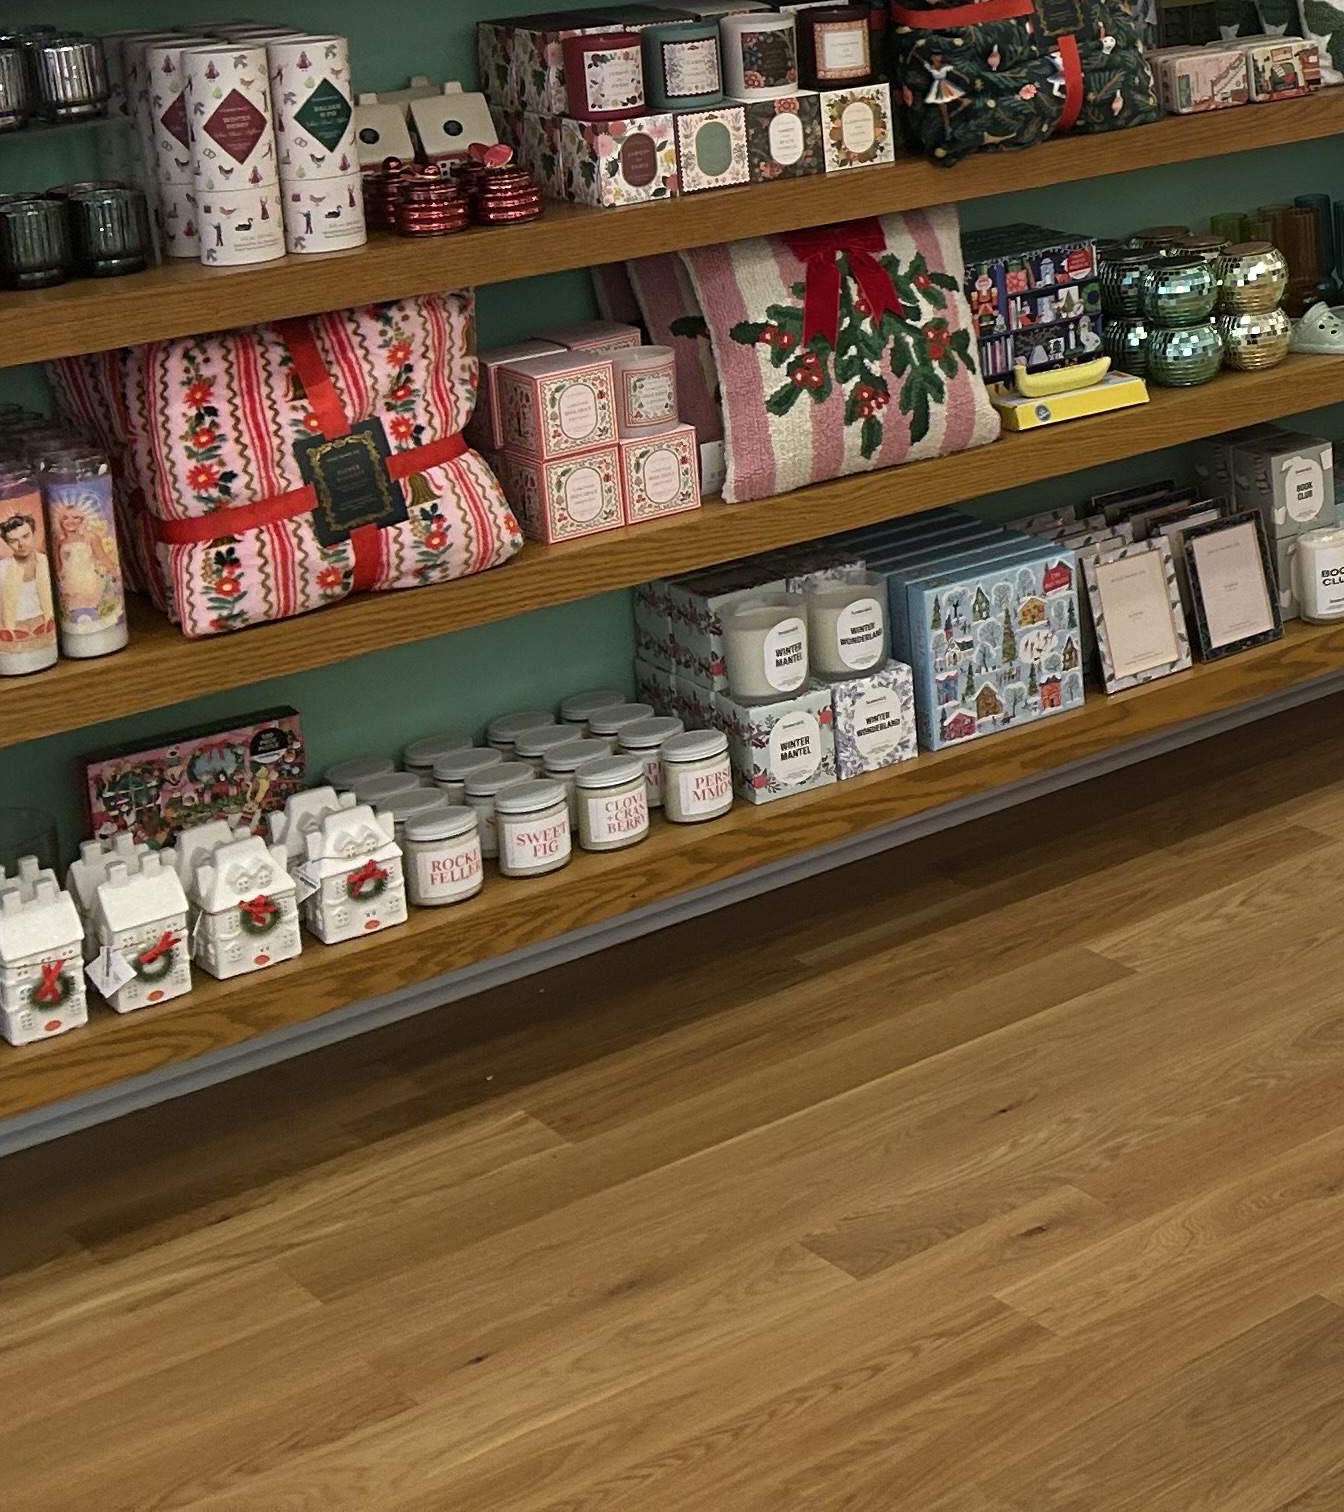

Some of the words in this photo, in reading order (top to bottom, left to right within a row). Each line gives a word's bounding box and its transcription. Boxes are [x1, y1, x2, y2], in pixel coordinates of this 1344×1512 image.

[1297, 481, 1313, 492] BOOK
[1297, 490, 1313, 501] CLUB
[775, 642, 802, 658] WINTER
[775, 651, 803, 668] MANTEL
[866, 711, 890, 725] WINTER
[780, 735, 810, 752] WINTER
[780, 746, 811, 761] MANTEL
[516, 821, 567, 847] SWEET
[532, 839, 559, 858] FIG
